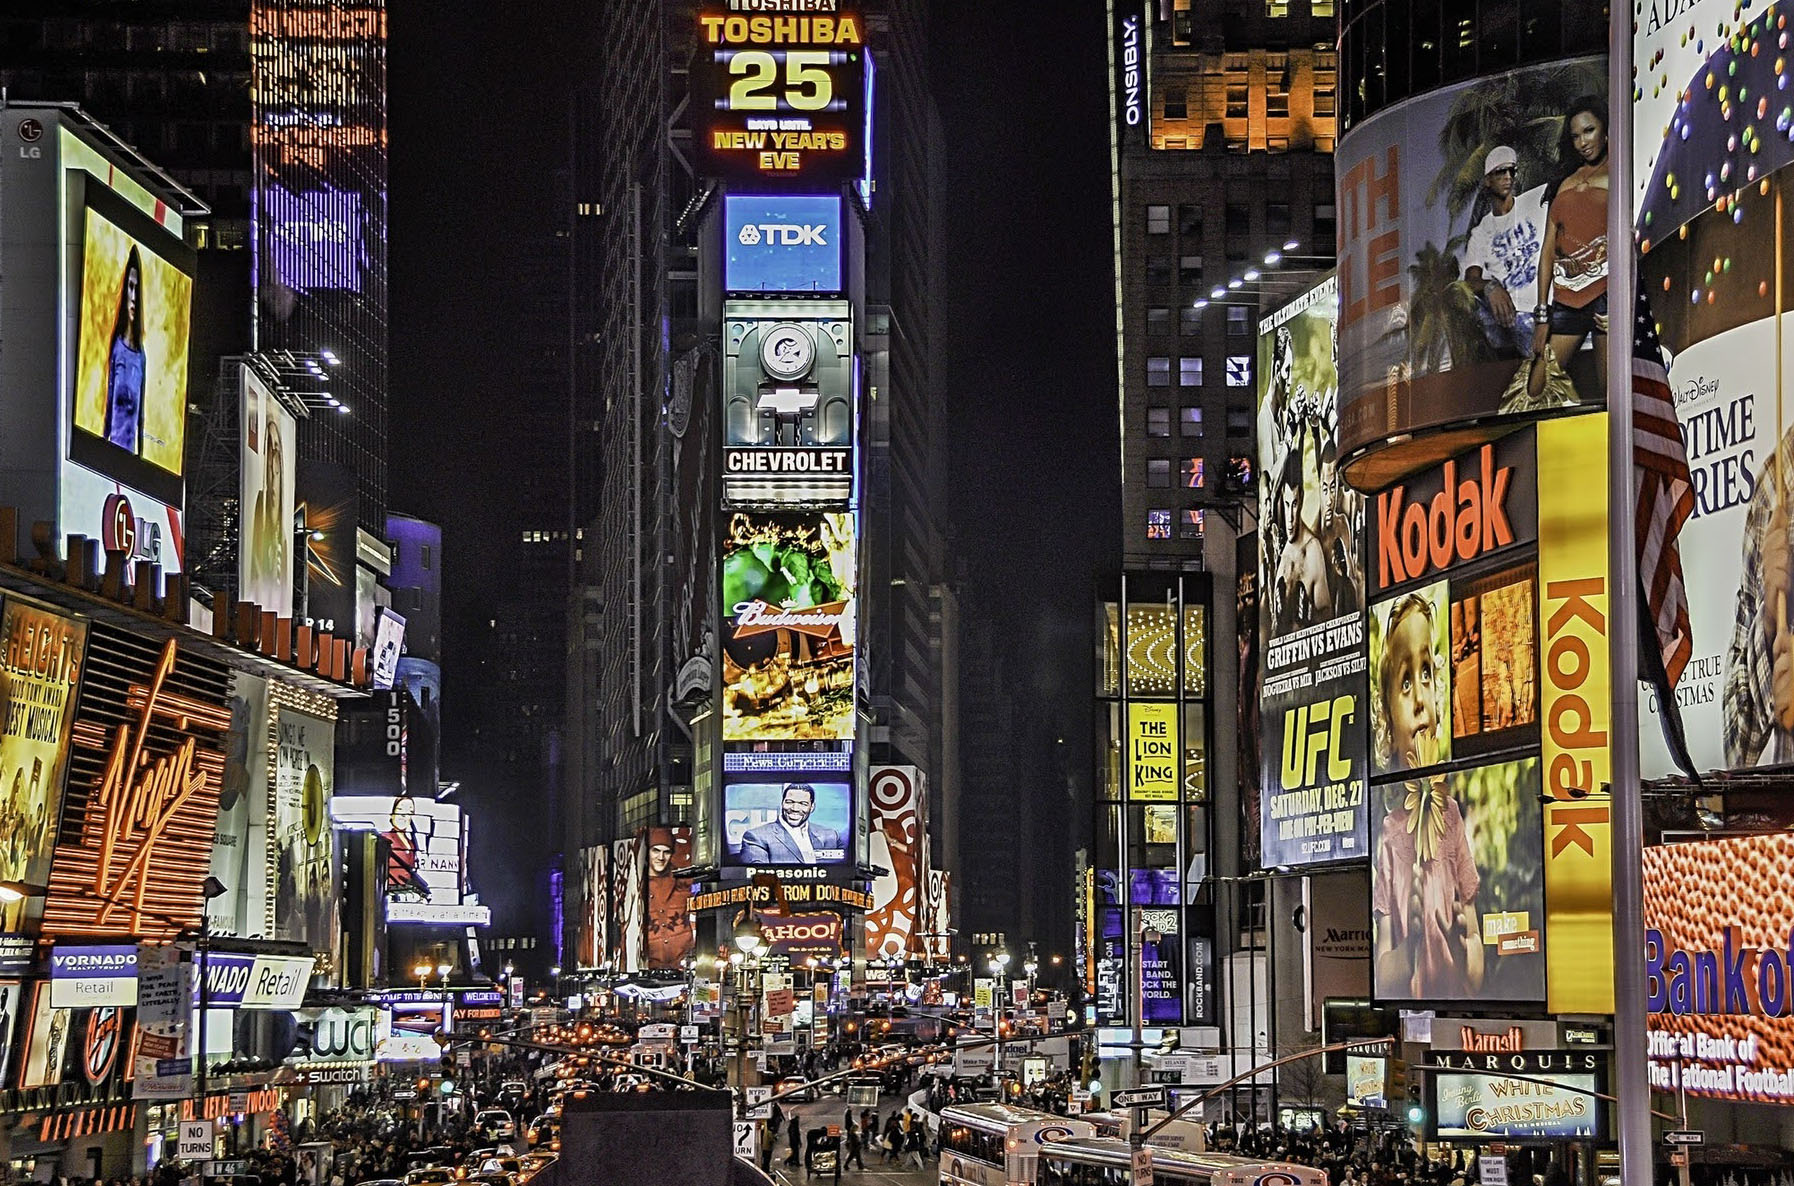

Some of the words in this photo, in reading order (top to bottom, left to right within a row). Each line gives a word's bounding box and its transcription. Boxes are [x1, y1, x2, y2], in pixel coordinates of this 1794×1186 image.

[701, 17, 860, 43] TOSHIBA
[729, 51, 832, 110] 25
[714, 132, 767, 149] NEW
[769, 132, 845, 149] YEAR'S
[20, 147, 41, 159] LG
[759, 152, 800, 169] EVE
[759, 224, 827, 245] TDK
[1679, 394, 1756, 460] TIME
[728, 452, 846, 471] CHEVROLET
[1691, 449, 1755, 520] RIES
[1377, 444, 1515, 589] Kodak
[135, 516, 162, 562] LG
[318, 617, 334, 631] 14
[732, 600, 843, 627] Budweiser
[1267, 638, 1310, 670] GRIFFIN
[1311, 633, 1325, 656] VS
[1326, 621, 1363, 652] EVANS
[1690, 655, 1722, 682] TRUE
[1649, 682, 1715, 714] CSTMAS
[4, 701, 26, 736] BEST
[25, 704, 60, 744] MUSICAL
[387, 692, 400, 756] 1500
[1140, 722, 1167, 735] THE
[1547, 576, 1609, 859] Kodak
[1135, 738, 1171, 761] LION
[1281, 694, 1356, 791] UFC
[743, 756, 773, 768] News
[1135, 764, 1173, 787] KING
[1271, 788, 1323, 820] SATURDAY,
[1324, 783, 1348, 810] DEC.
[1350, 780, 1363, 806] 27
[776, 885, 810, 900] ROM
[1486, 911, 1518, 937] make
[53, 954, 138, 967] VORNADO
[1646, 925, 1750, 1016] Bank
[255, 966, 301, 996] Retail
[1146, 971, 1173, 979] BAND.
[1195, 942, 1204, 1019] ROCKBAND.COM
[75, 981, 114, 994] Retail
[1696, 1032, 1735, 1059] Bank
[1738, 1033, 1756, 1061] of
[1436, 1055, 1596, 1069] MARQUIS
[309, 1068, 360, 1083] swatch
[1153, 1073, 1160, 1082] W
[1162, 1072, 1172, 1082] 46
[1118, 1095, 1134, 1103] ONE
[1141, 1092, 1158, 1101] WAY
[1466, 1095, 1586, 1132] CHRISTMAS
[188, 1127, 203, 1138] NO
[180, 1142, 211, 1154] TURNS
[1138, 1154, 1147, 1164] NO
[216, 1163, 223, 1174] W
[224, 1162, 235, 1174] 46
[1136, 1165, 1151, 1177] TURNS
